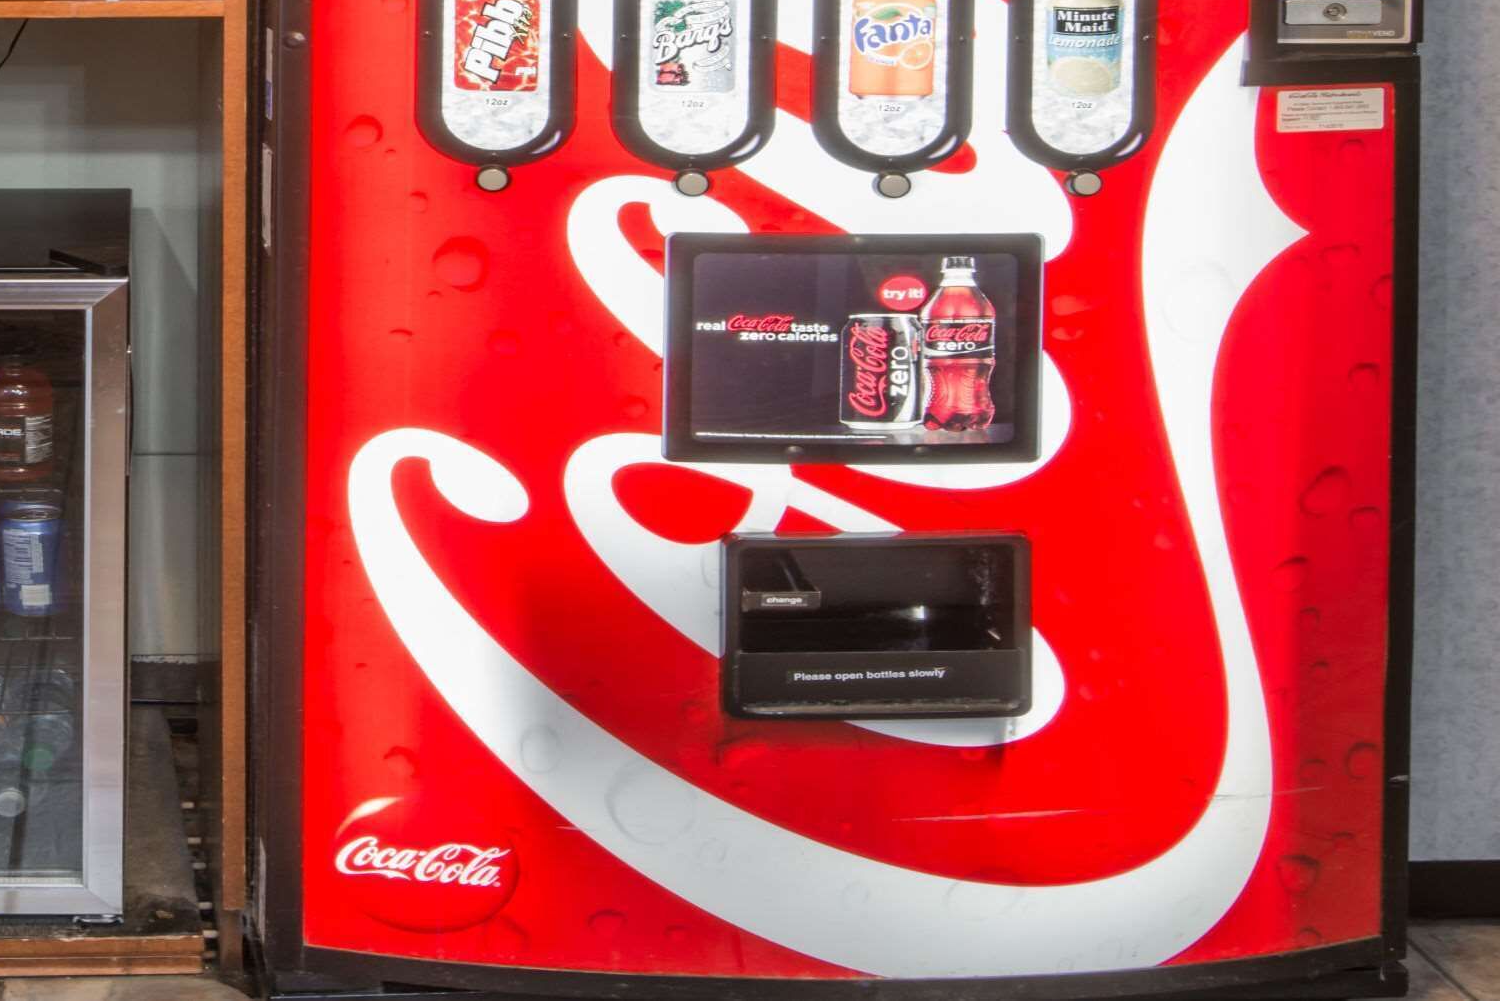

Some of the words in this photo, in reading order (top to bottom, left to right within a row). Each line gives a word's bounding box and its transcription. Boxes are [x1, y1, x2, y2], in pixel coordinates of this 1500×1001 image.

[1057, 9, 1117, 23] Minute
[853, 13, 934, 53] Fanta
[1064, 21, 1111, 34] Maid
[1048, 32, 1123, 50] Lemonade
[485, 98, 509, 107] 12oz
[882, 287, 906, 301] try
[908, 287, 926, 300] it!
[696, 320, 727, 332] real
[791, 321, 829, 334] taste
[739, 331, 777, 341] zero
[778, 330, 838, 343] calories
[936, 339, 977, 352] zero
[890, 344, 910, 397] zero
[765, 595, 803, 606] change
[793, 672, 832, 682] Please
[834, 671, 864, 682] open
[866, 669, 906, 680] bottles
[908, 667, 947, 680] slowly
[334, 835, 512, 888] Coca-Cola
